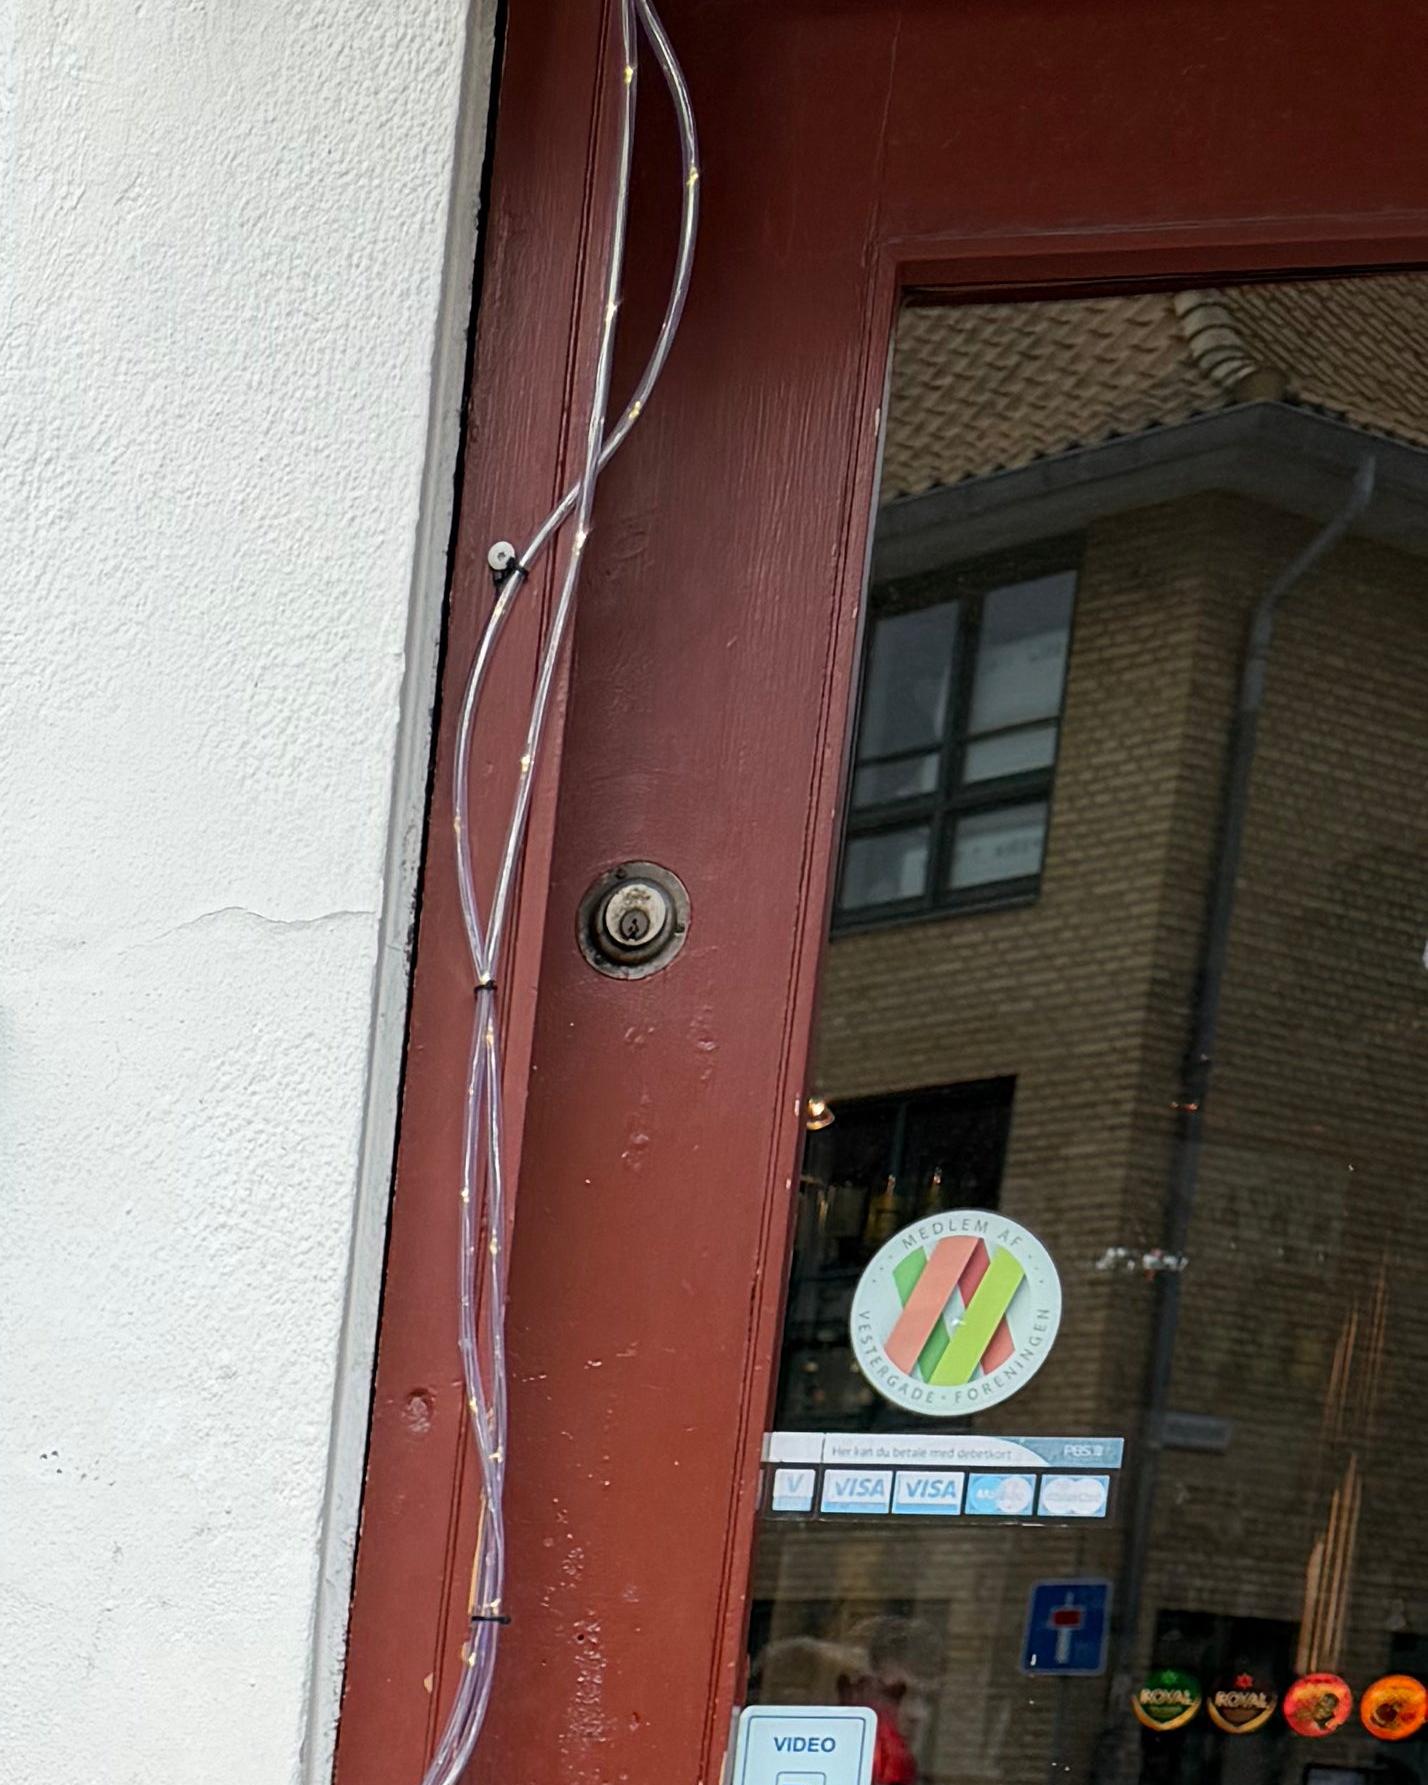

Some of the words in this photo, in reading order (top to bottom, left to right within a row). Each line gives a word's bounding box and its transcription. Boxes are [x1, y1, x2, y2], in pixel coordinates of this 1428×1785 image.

[901, 1218, 989, 1251] MEDLEM
[997, 1229, 1023, 1247] AF
[858, 1310, 935, 1404] VESTERGADE
[954, 1308, 1050, 1403] FORENINGEN
[835, 1477, 885, 1497] VISA
[905, 1479, 957, 1499] VISA
[1140, 1688, 1192, 1706] ROYAL
[1215, 1689, 1268, 1709] ROYAL
[773, 1736, 836, 1753] VIDEO
